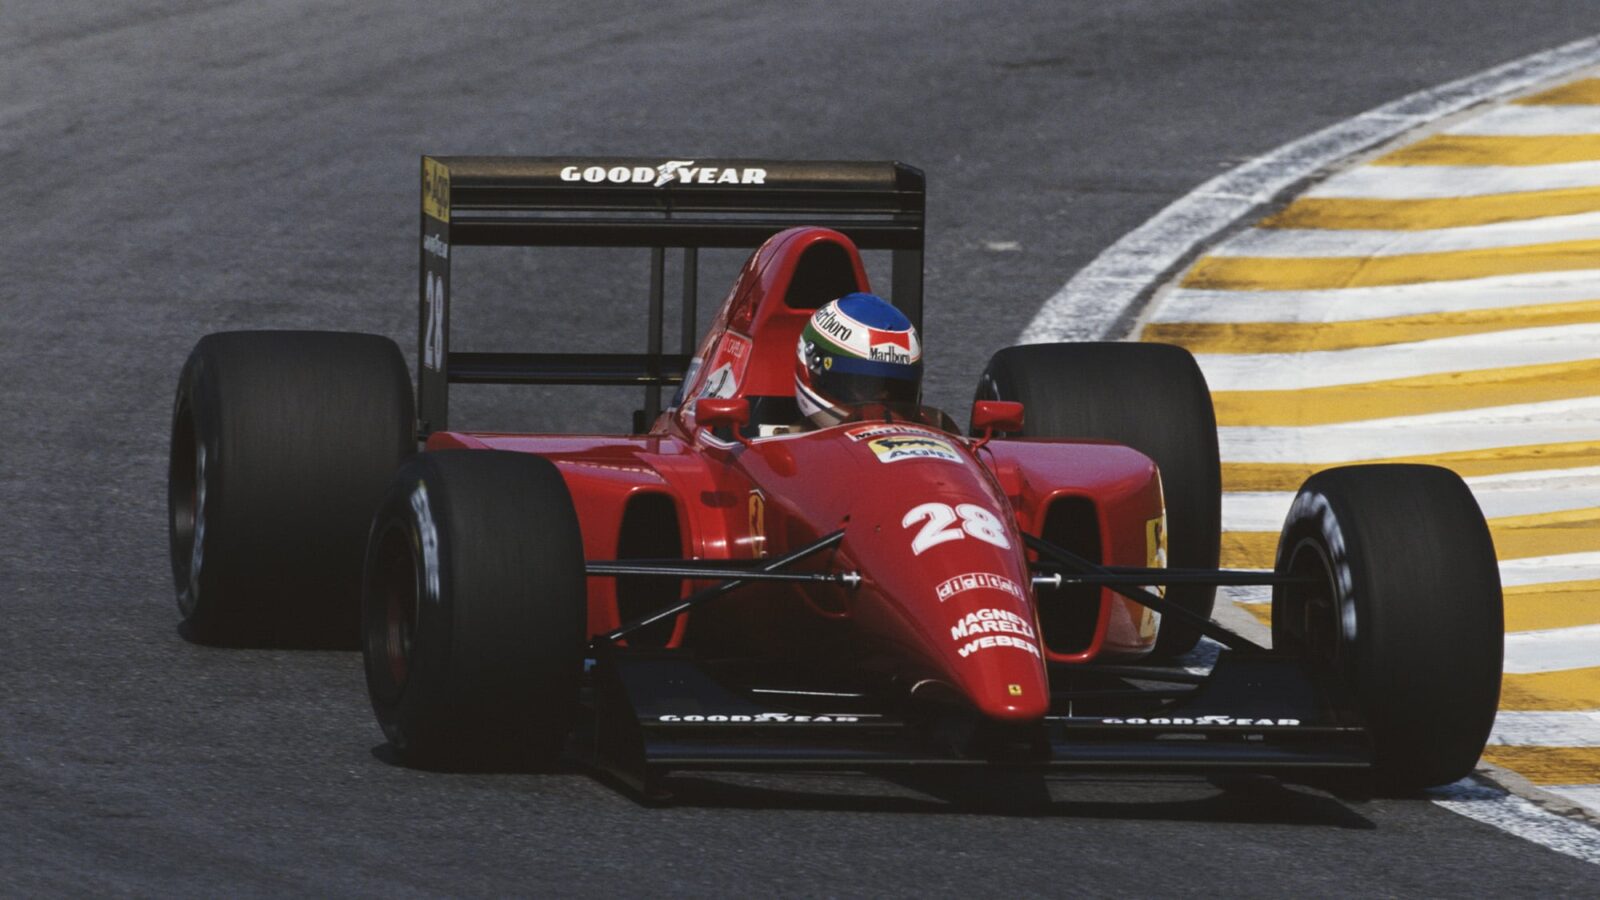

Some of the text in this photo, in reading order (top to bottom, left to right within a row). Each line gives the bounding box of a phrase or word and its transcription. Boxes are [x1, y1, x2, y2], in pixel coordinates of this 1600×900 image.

[424, 270, 443, 372] 28
[870, 345, 911, 364] Marlboro
[902, 503, 1011, 556] 28
[936, 573, 1025, 602] digital
[958, 635, 1041, 658] WEBER
